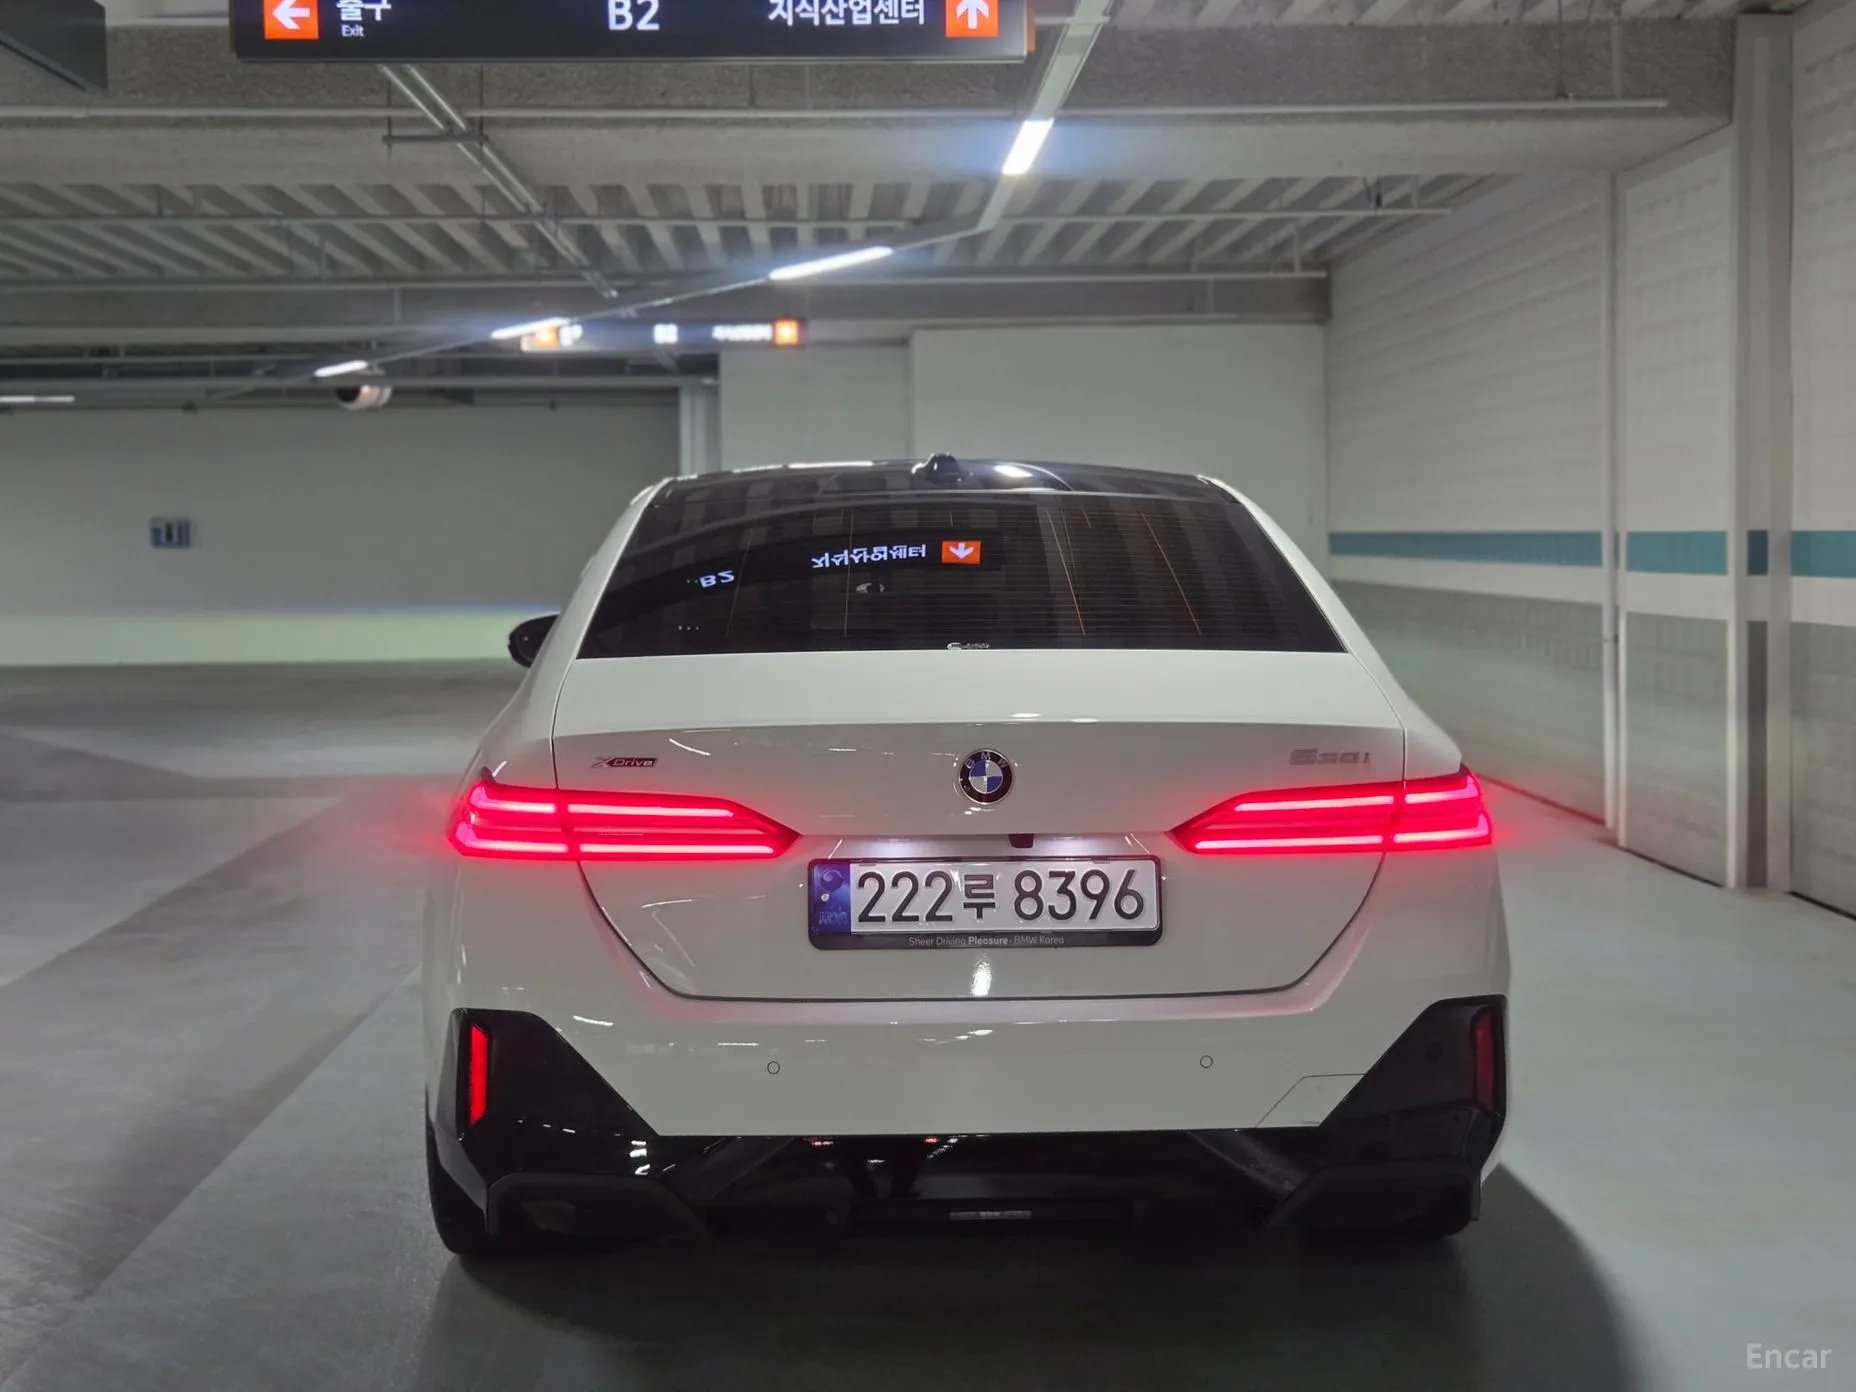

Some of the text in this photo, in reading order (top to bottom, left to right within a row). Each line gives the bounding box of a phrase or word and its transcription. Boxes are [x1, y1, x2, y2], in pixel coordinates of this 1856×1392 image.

[607, 0, 660, 31] B2
[767, 0, 925, 26] 지식산업센터
[341, 25, 364, 37] Exit
[858, 869, 1144, 923] 222루 8396
[908, 936, 934, 946] Sheer
[936, 936, 966, 946] Driving
[1014, 935, 1037, 944] BMW
[1039, 935, 1065, 944] Korea
